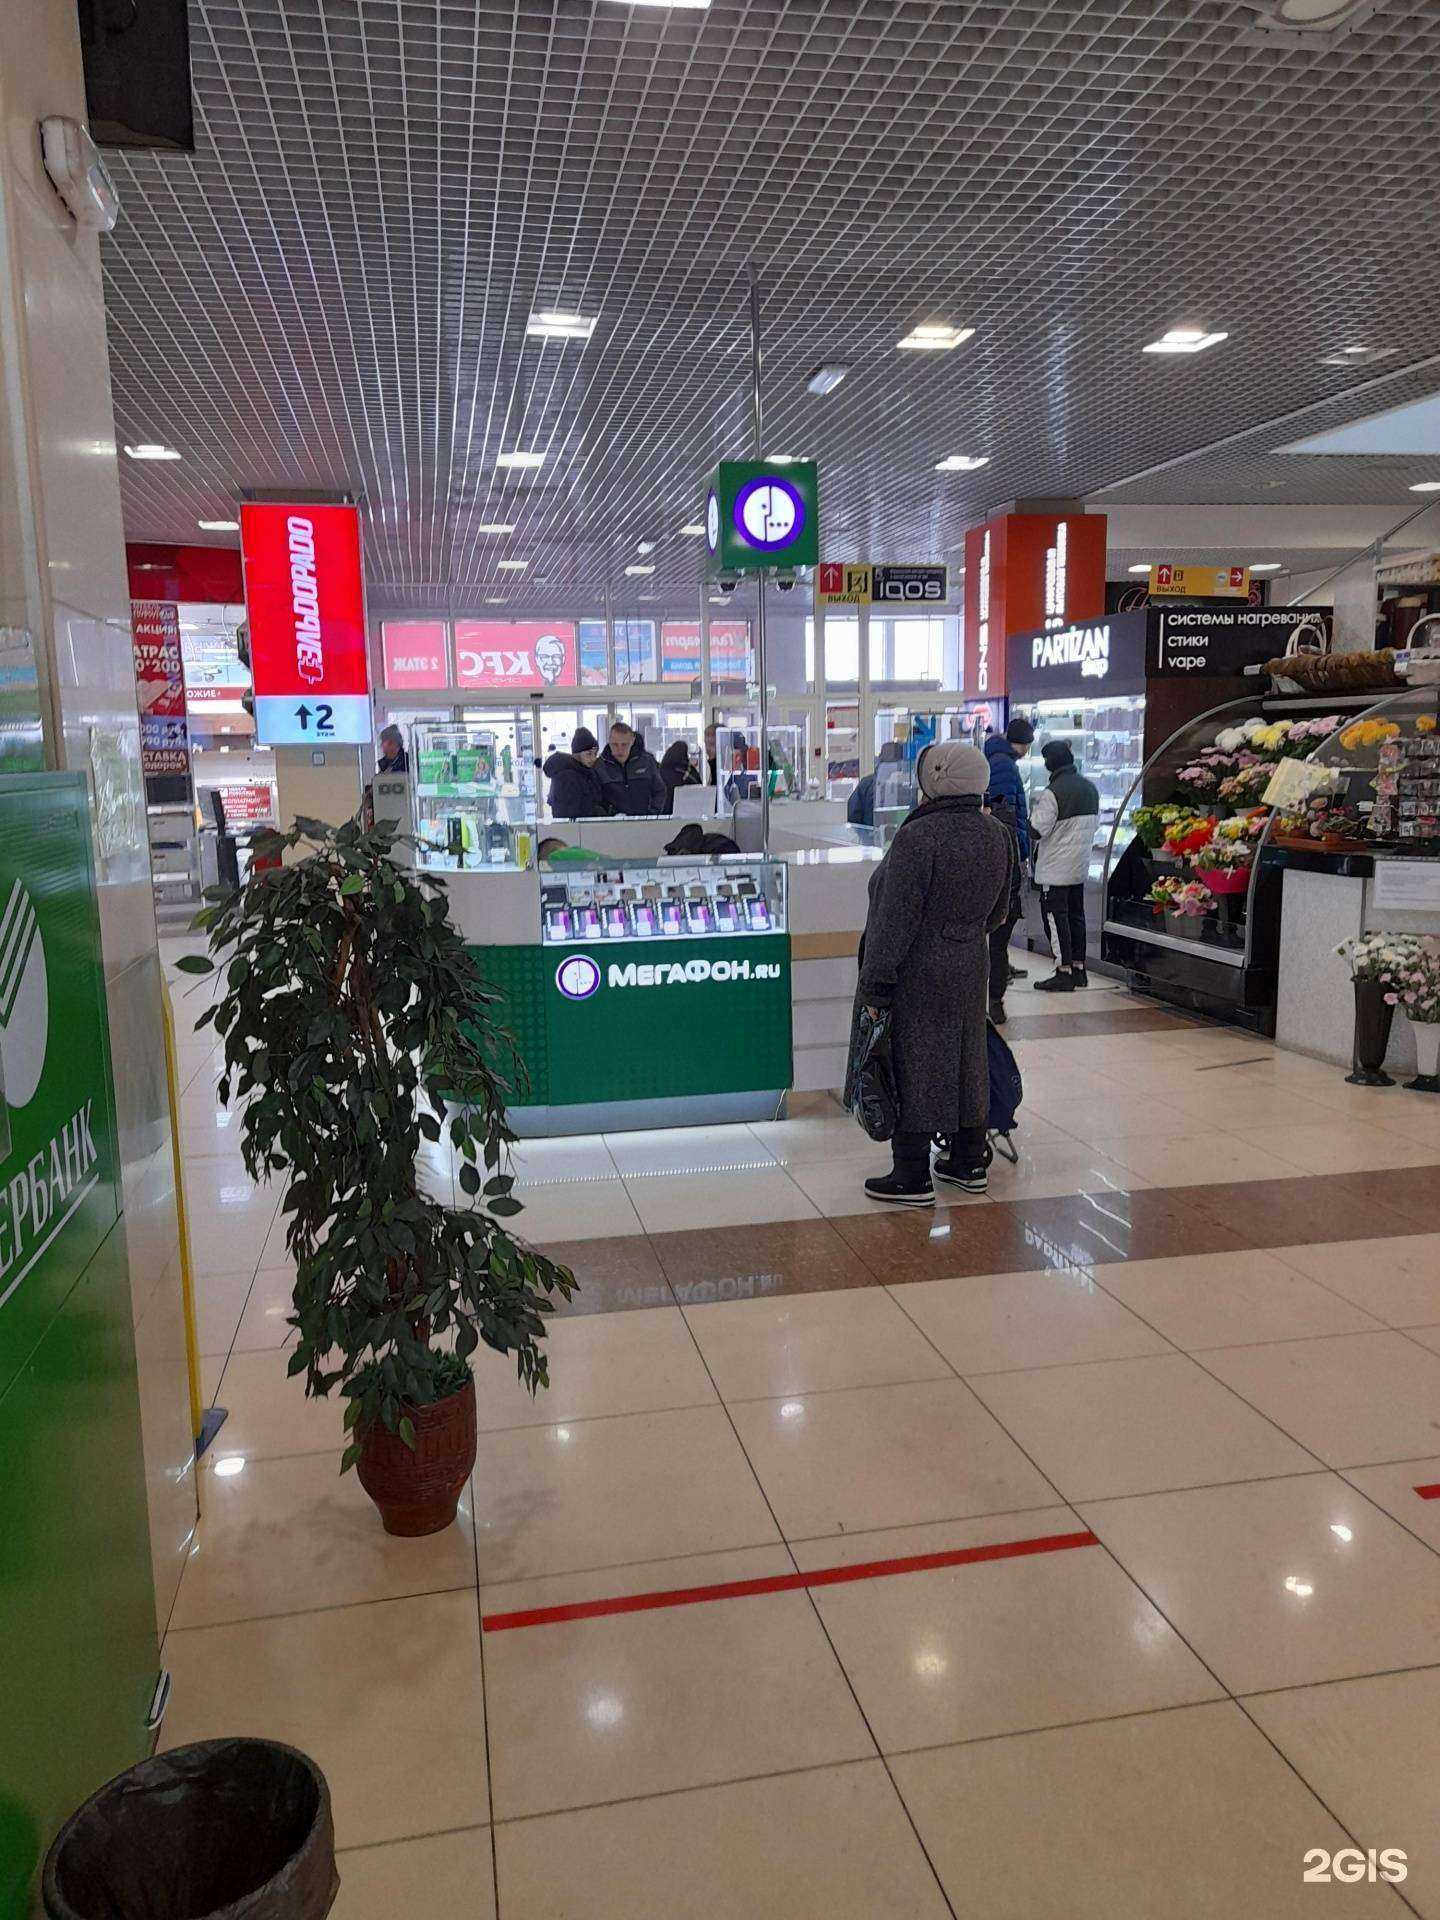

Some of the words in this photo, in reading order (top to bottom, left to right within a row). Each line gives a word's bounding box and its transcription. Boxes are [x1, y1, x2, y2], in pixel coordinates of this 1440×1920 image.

[1167, 613, 1235, 627] системы
[1032, 625, 1110, 669] PARTIZAN
[1167, 635, 1209, 648] стики
[1168, 655, 1207, 671] vape
[315, 704, 335, 730] 2
